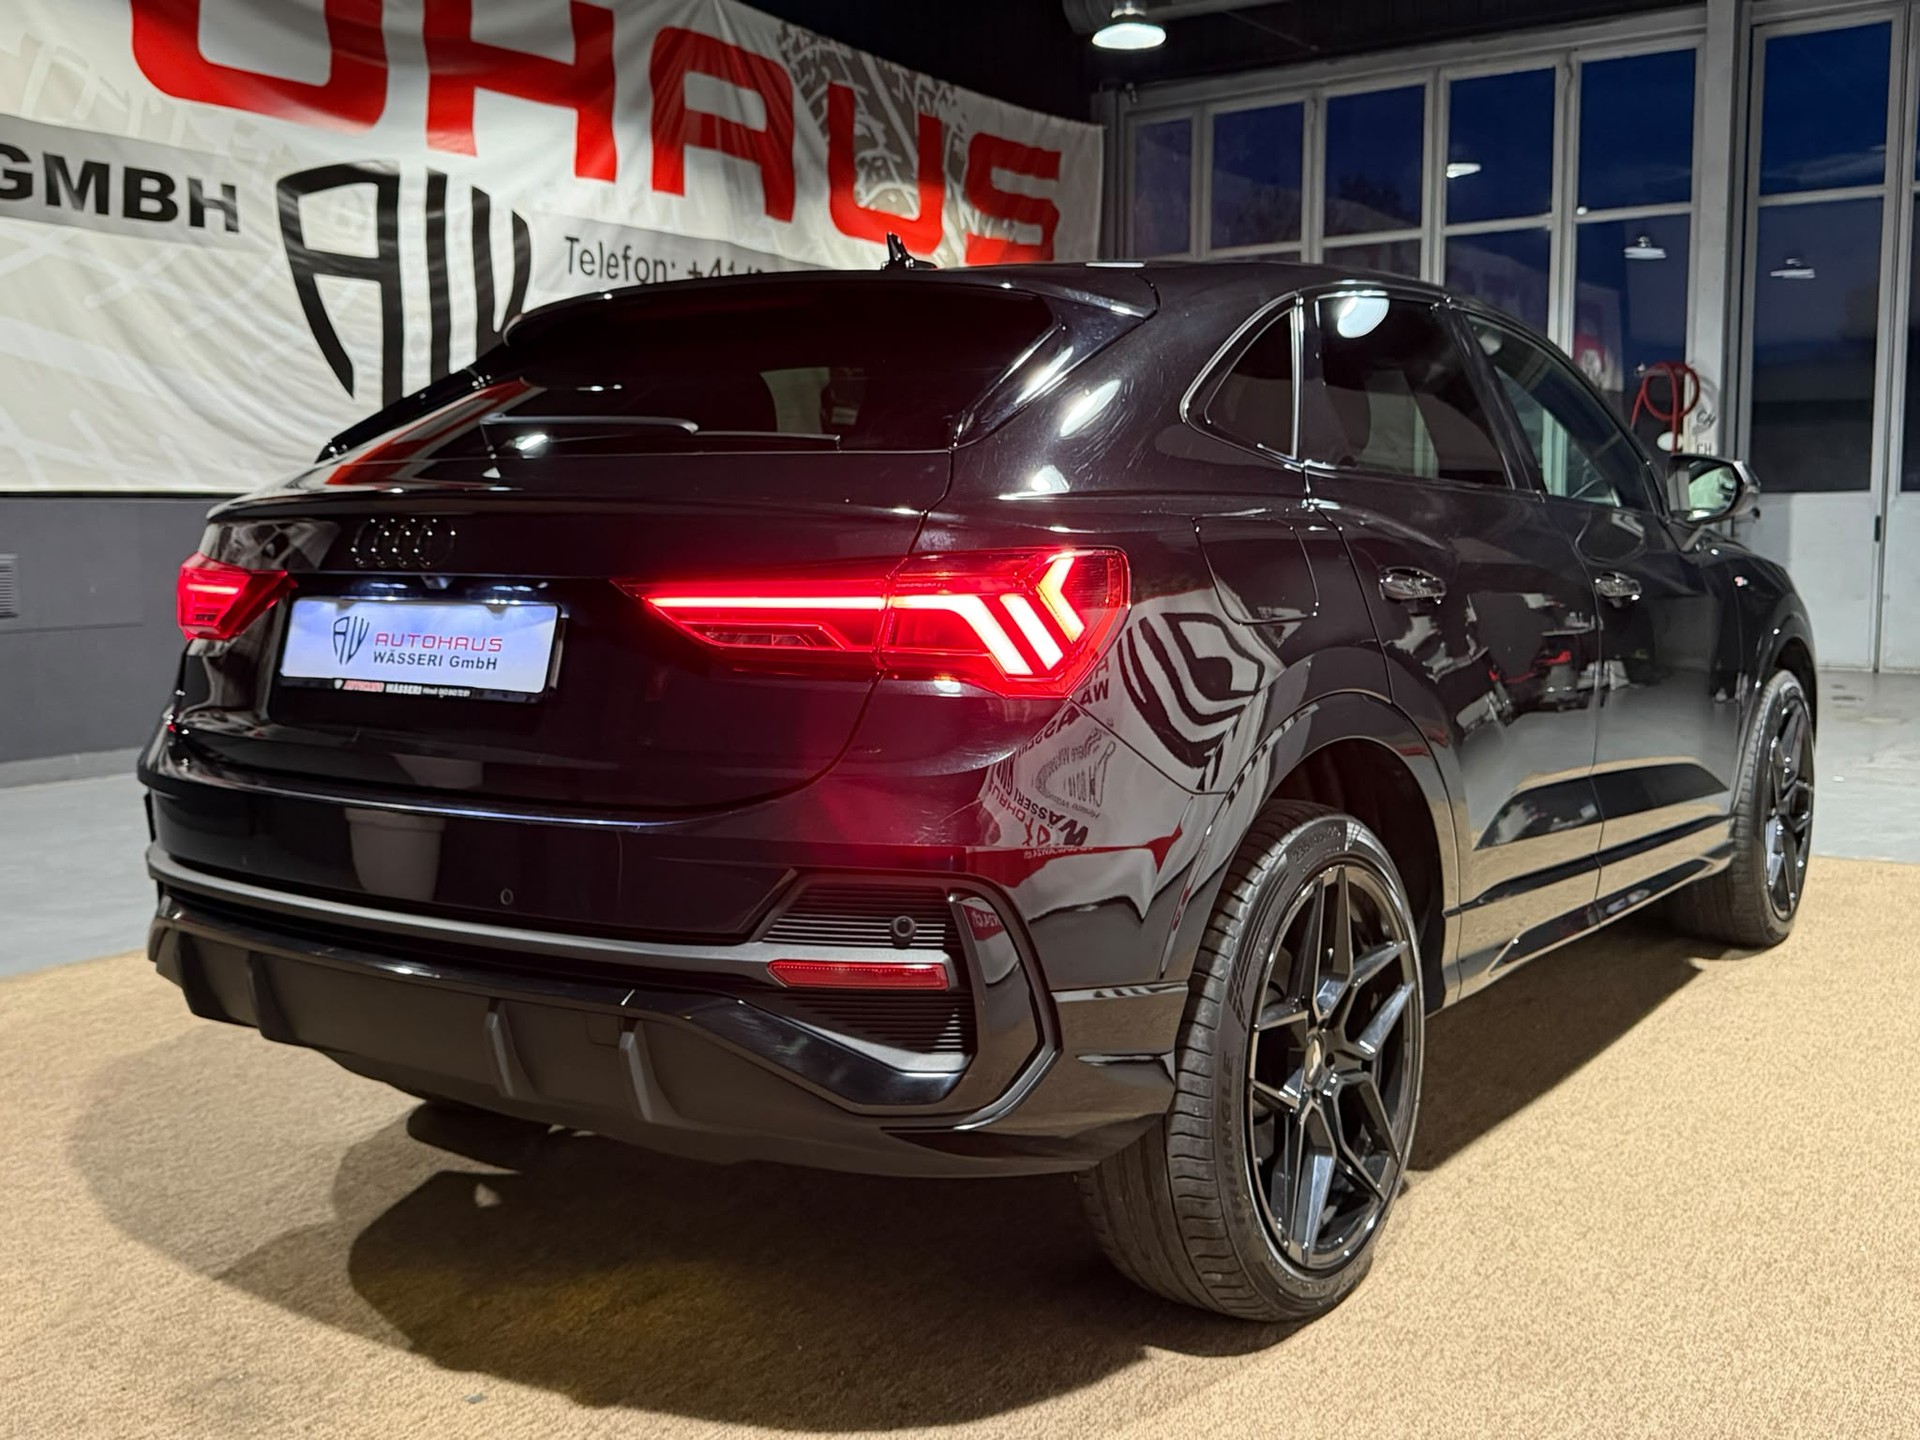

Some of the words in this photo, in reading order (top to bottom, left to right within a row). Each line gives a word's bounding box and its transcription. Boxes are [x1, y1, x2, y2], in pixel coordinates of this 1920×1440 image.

[565, 236, 676, 285] Telefon:
[374, 632, 503, 652] AUTOHAUS
[373, 650, 443, 667] WÄSSERI
[449, 655, 498, 671] GmbH
